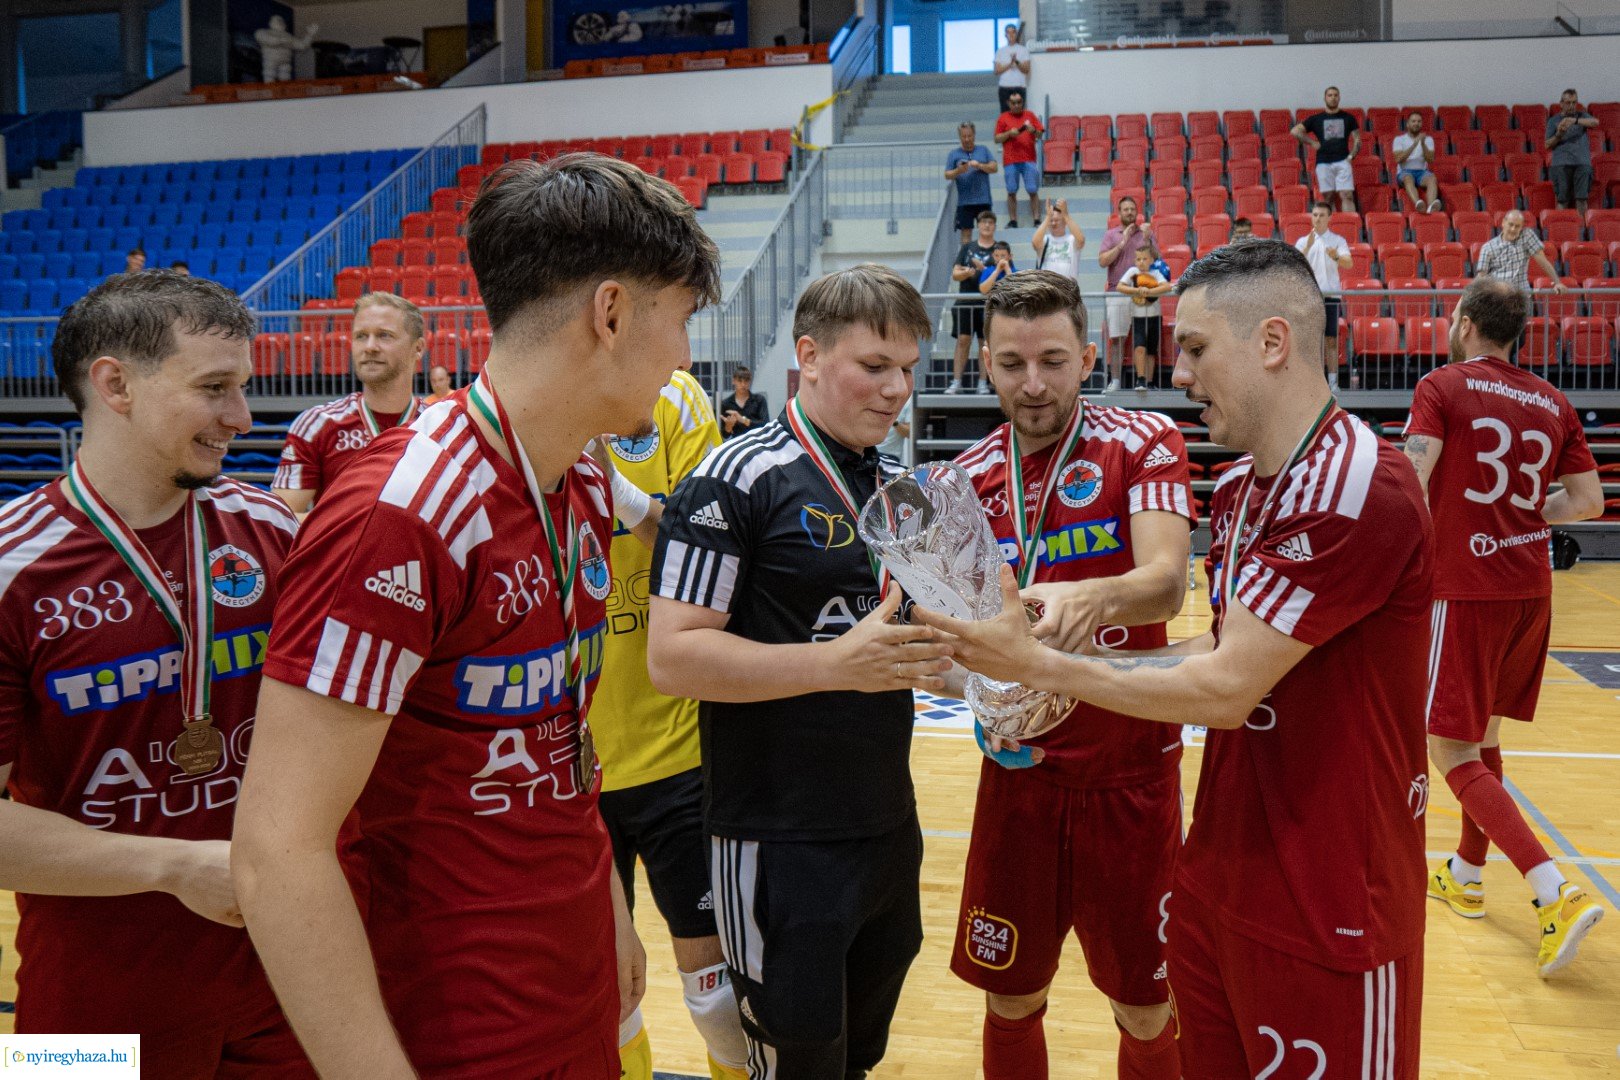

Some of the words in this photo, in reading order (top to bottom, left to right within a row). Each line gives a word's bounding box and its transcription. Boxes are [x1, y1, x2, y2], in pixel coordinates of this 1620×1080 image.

[1143, 455, 1179, 469] adidas
[1464, 417, 1552, 511] 33
[689, 514, 729, 530] adidas
[999, 521, 1120, 562] PPMIX
[1500, 528, 1551, 548] NYÍREGYHÁZ
[208, 546, 250, 561] UTSAL
[364, 576, 426, 612] adidas
[494, 554, 550, 624] 383
[34, 580, 133, 640] 383
[82, 776, 241, 829] STUD
[470, 764, 578, 815] STU
[971, 933, 1008, 952] SUNSHINE
[973, 918, 1009, 943] 99.4
[976, 945, 996, 962] FM
